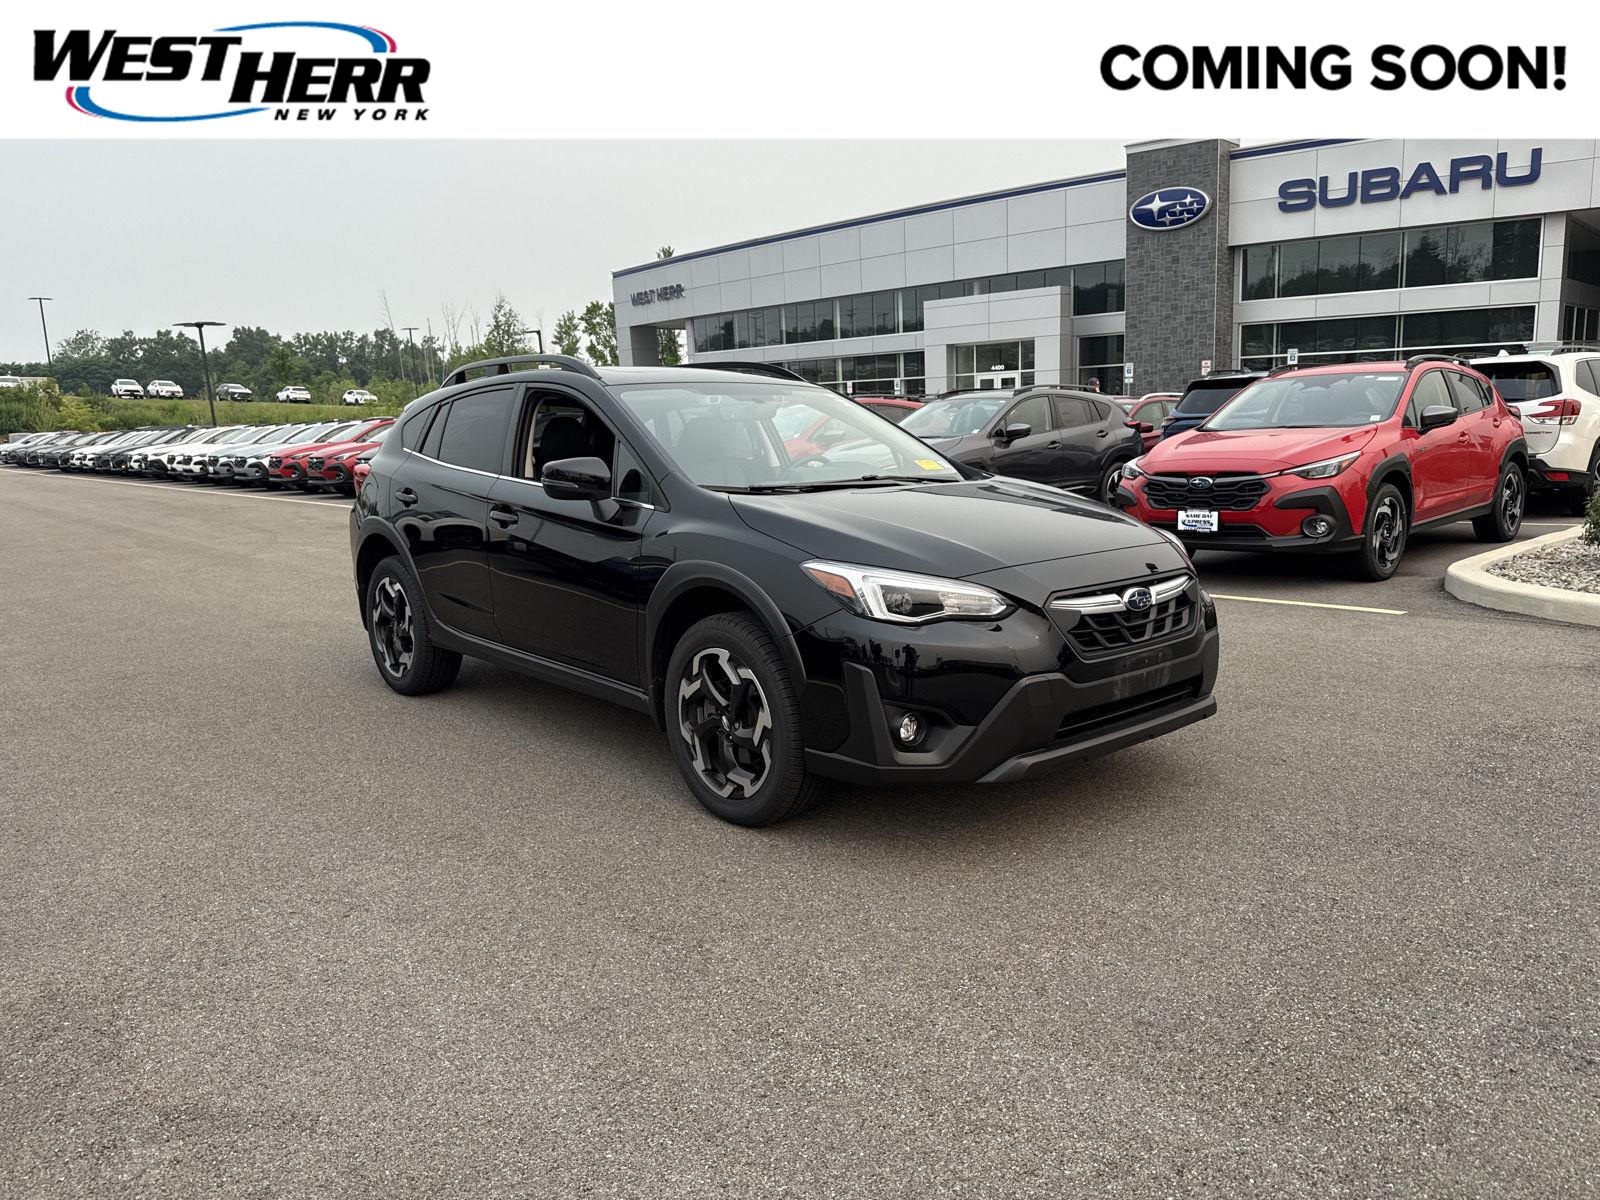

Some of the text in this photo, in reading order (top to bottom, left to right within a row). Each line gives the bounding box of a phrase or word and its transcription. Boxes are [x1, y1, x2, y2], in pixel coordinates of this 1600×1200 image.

[1277, 147, 1543, 213] SUBARU
[630, 283, 685, 307] WEST HERR
